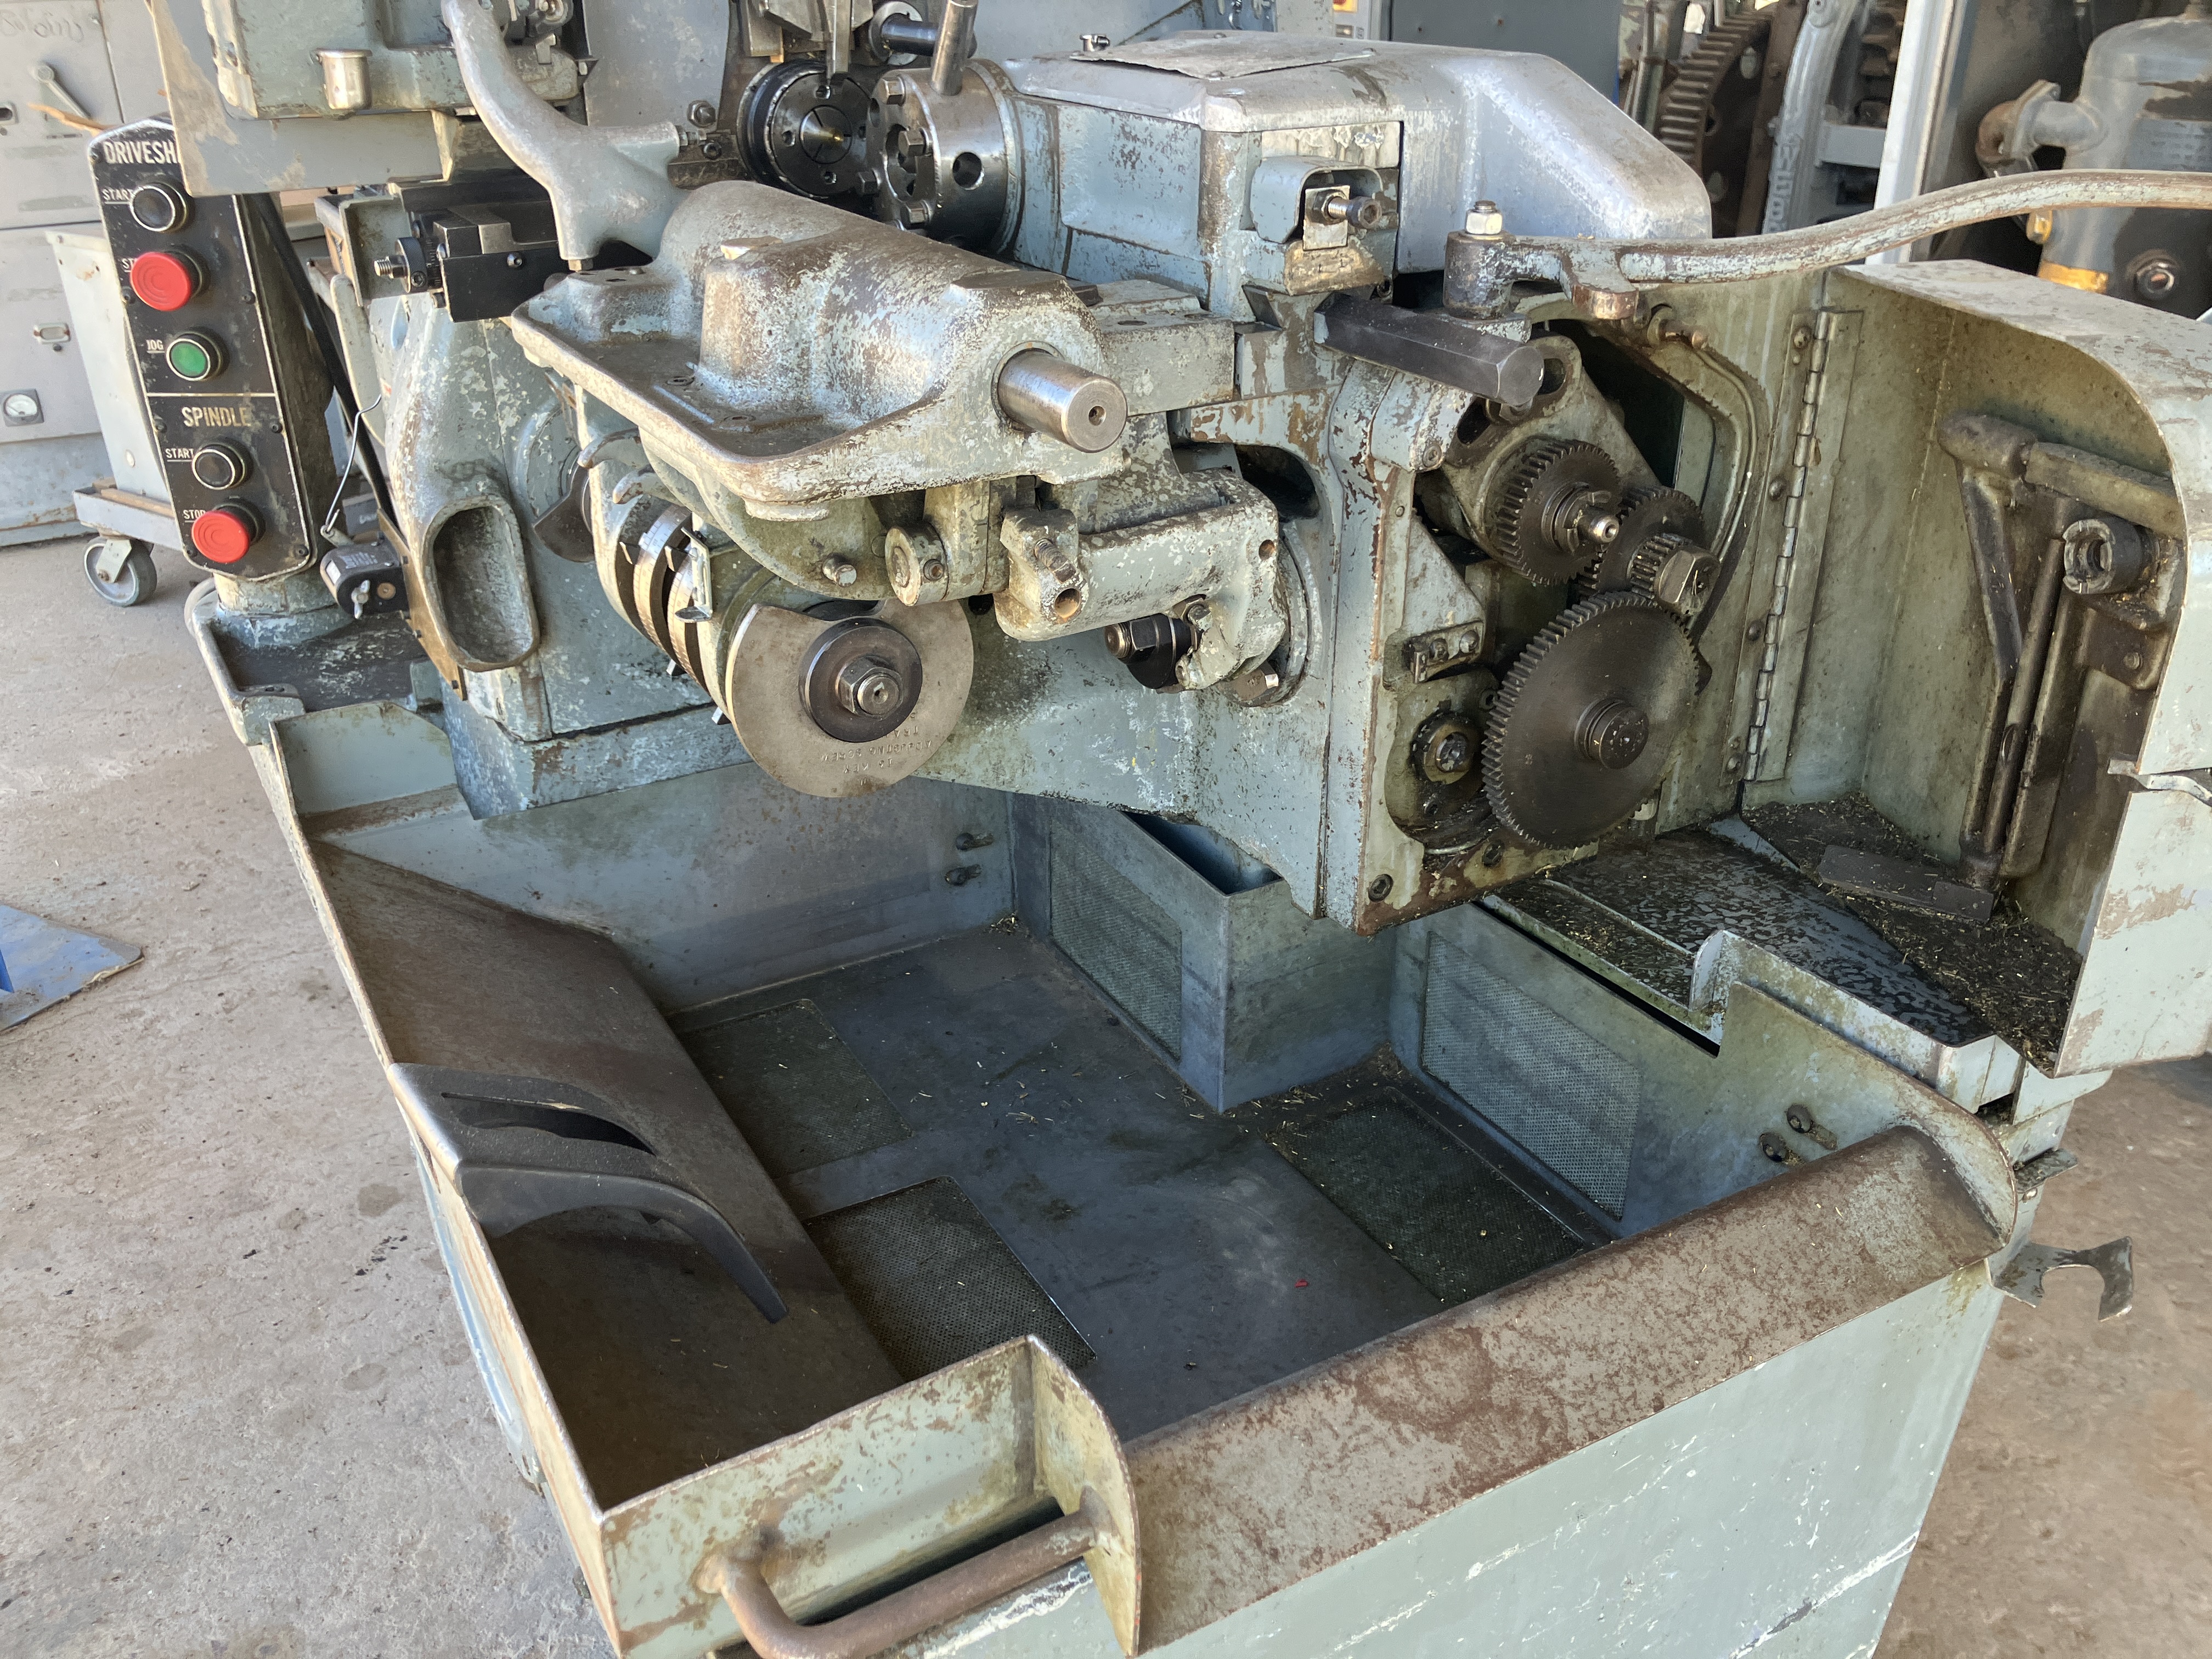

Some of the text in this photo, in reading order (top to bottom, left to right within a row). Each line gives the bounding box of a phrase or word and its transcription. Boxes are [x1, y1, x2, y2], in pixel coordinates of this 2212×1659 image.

[182, 407, 252, 427] SPINDLE
[165, 448, 194, 459] START
[843, 762, 869, 774] KEY
